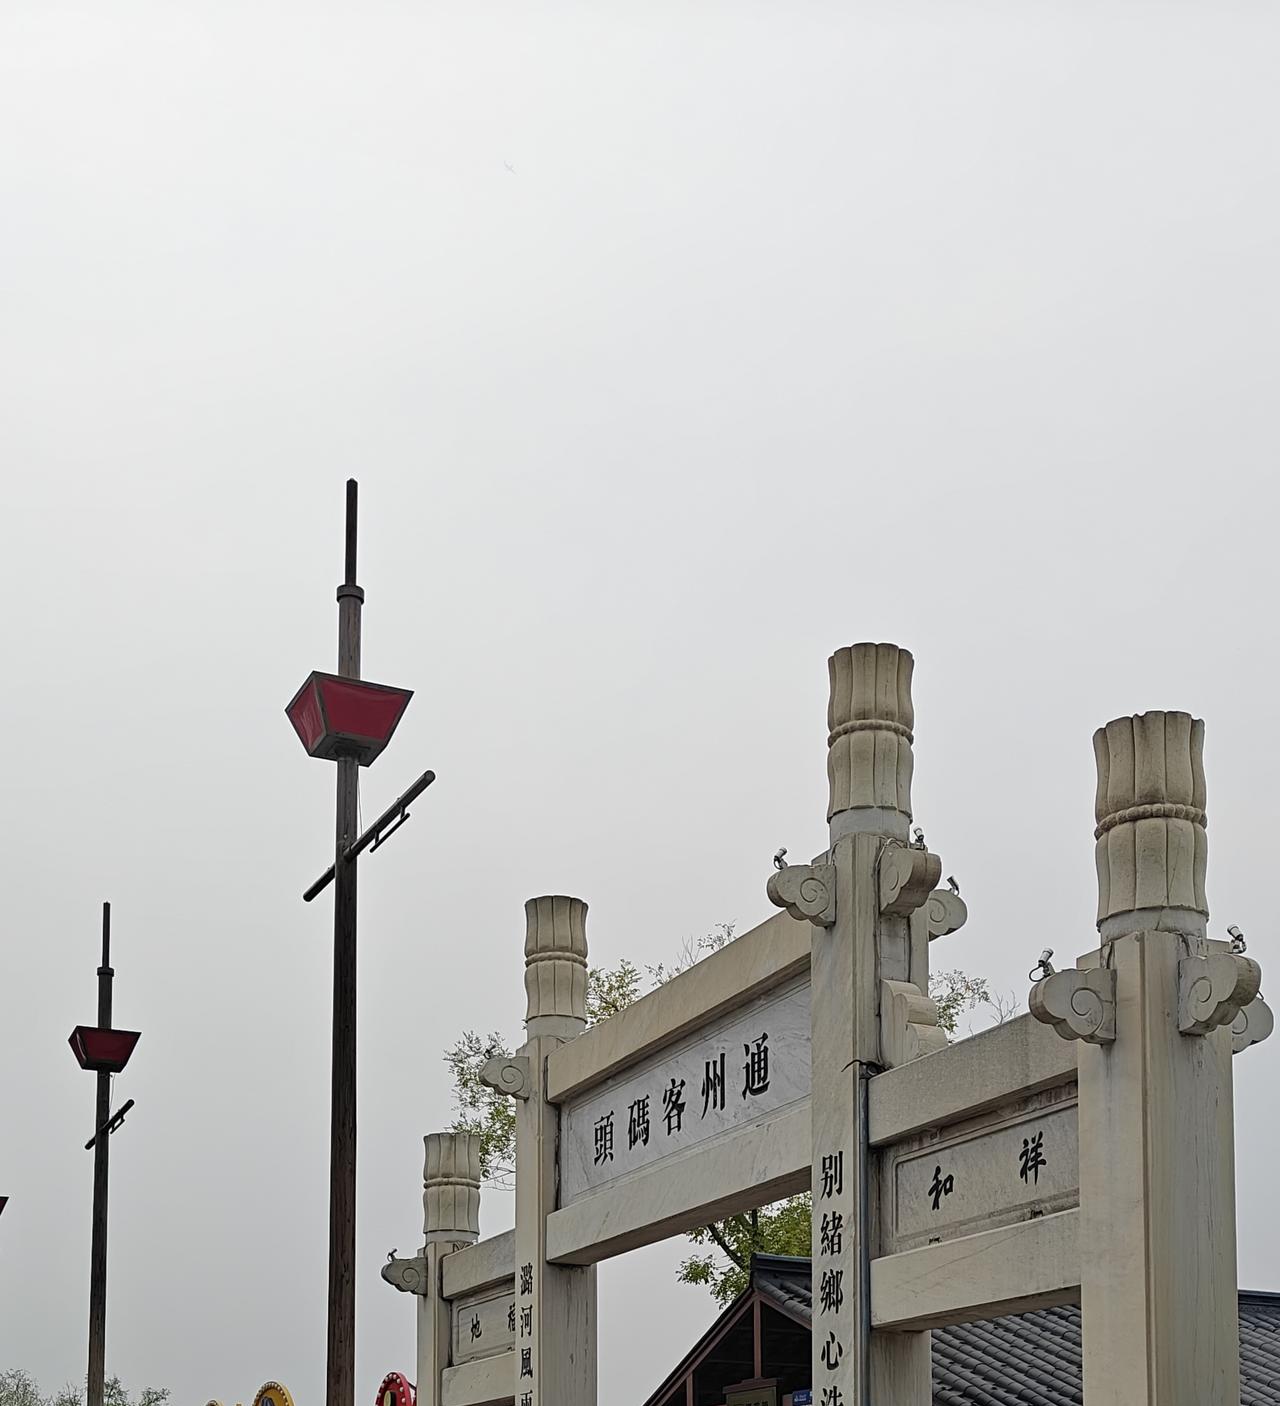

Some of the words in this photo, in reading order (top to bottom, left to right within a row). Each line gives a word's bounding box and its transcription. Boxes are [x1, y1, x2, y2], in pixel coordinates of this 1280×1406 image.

[593, 1032, 770, 1166] 通州客碼頭
[928, 1131, 1047, 1211] 祥和
